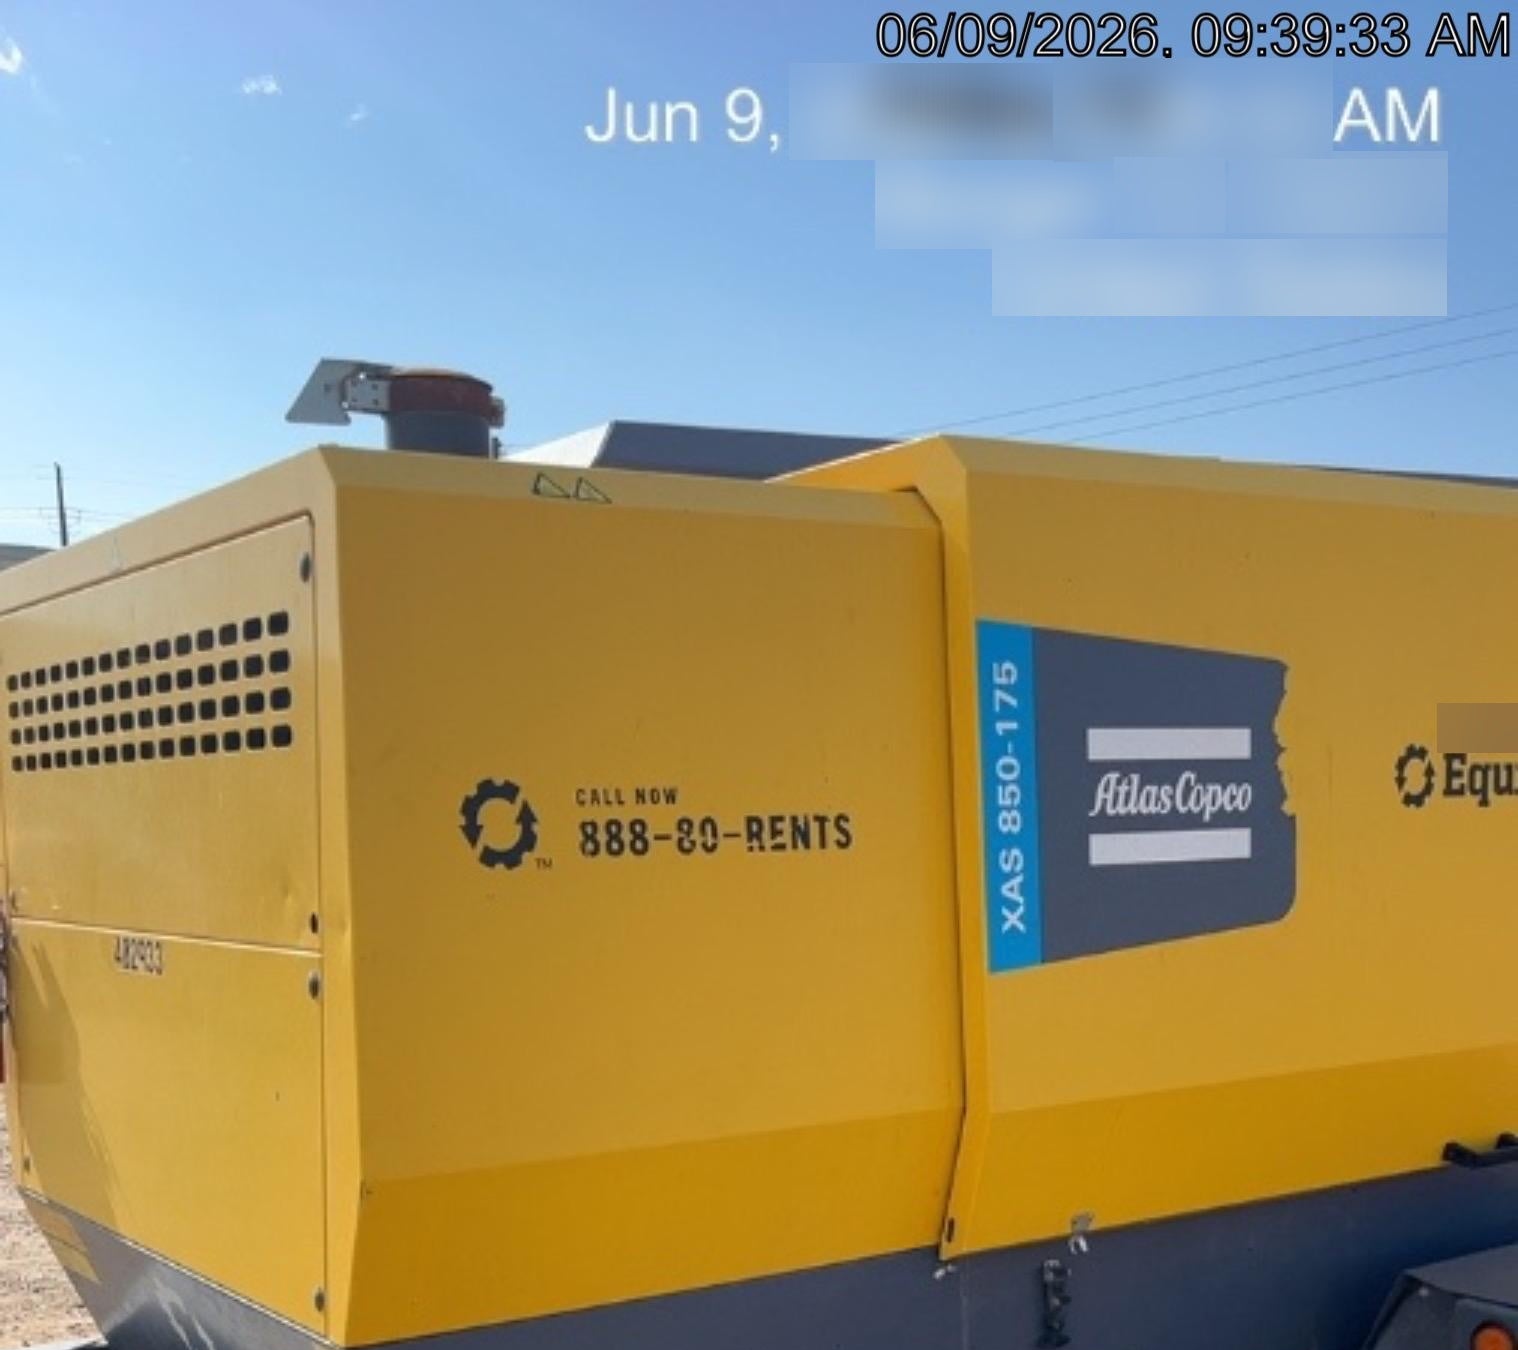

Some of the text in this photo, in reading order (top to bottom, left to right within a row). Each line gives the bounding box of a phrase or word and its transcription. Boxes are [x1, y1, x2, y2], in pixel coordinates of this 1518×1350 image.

[575, 787, 679, 807] CALL NOW
[992, 661, 1026, 933] XAS 850-175
[579, 812, 853, 857] 888-80-RENTS
